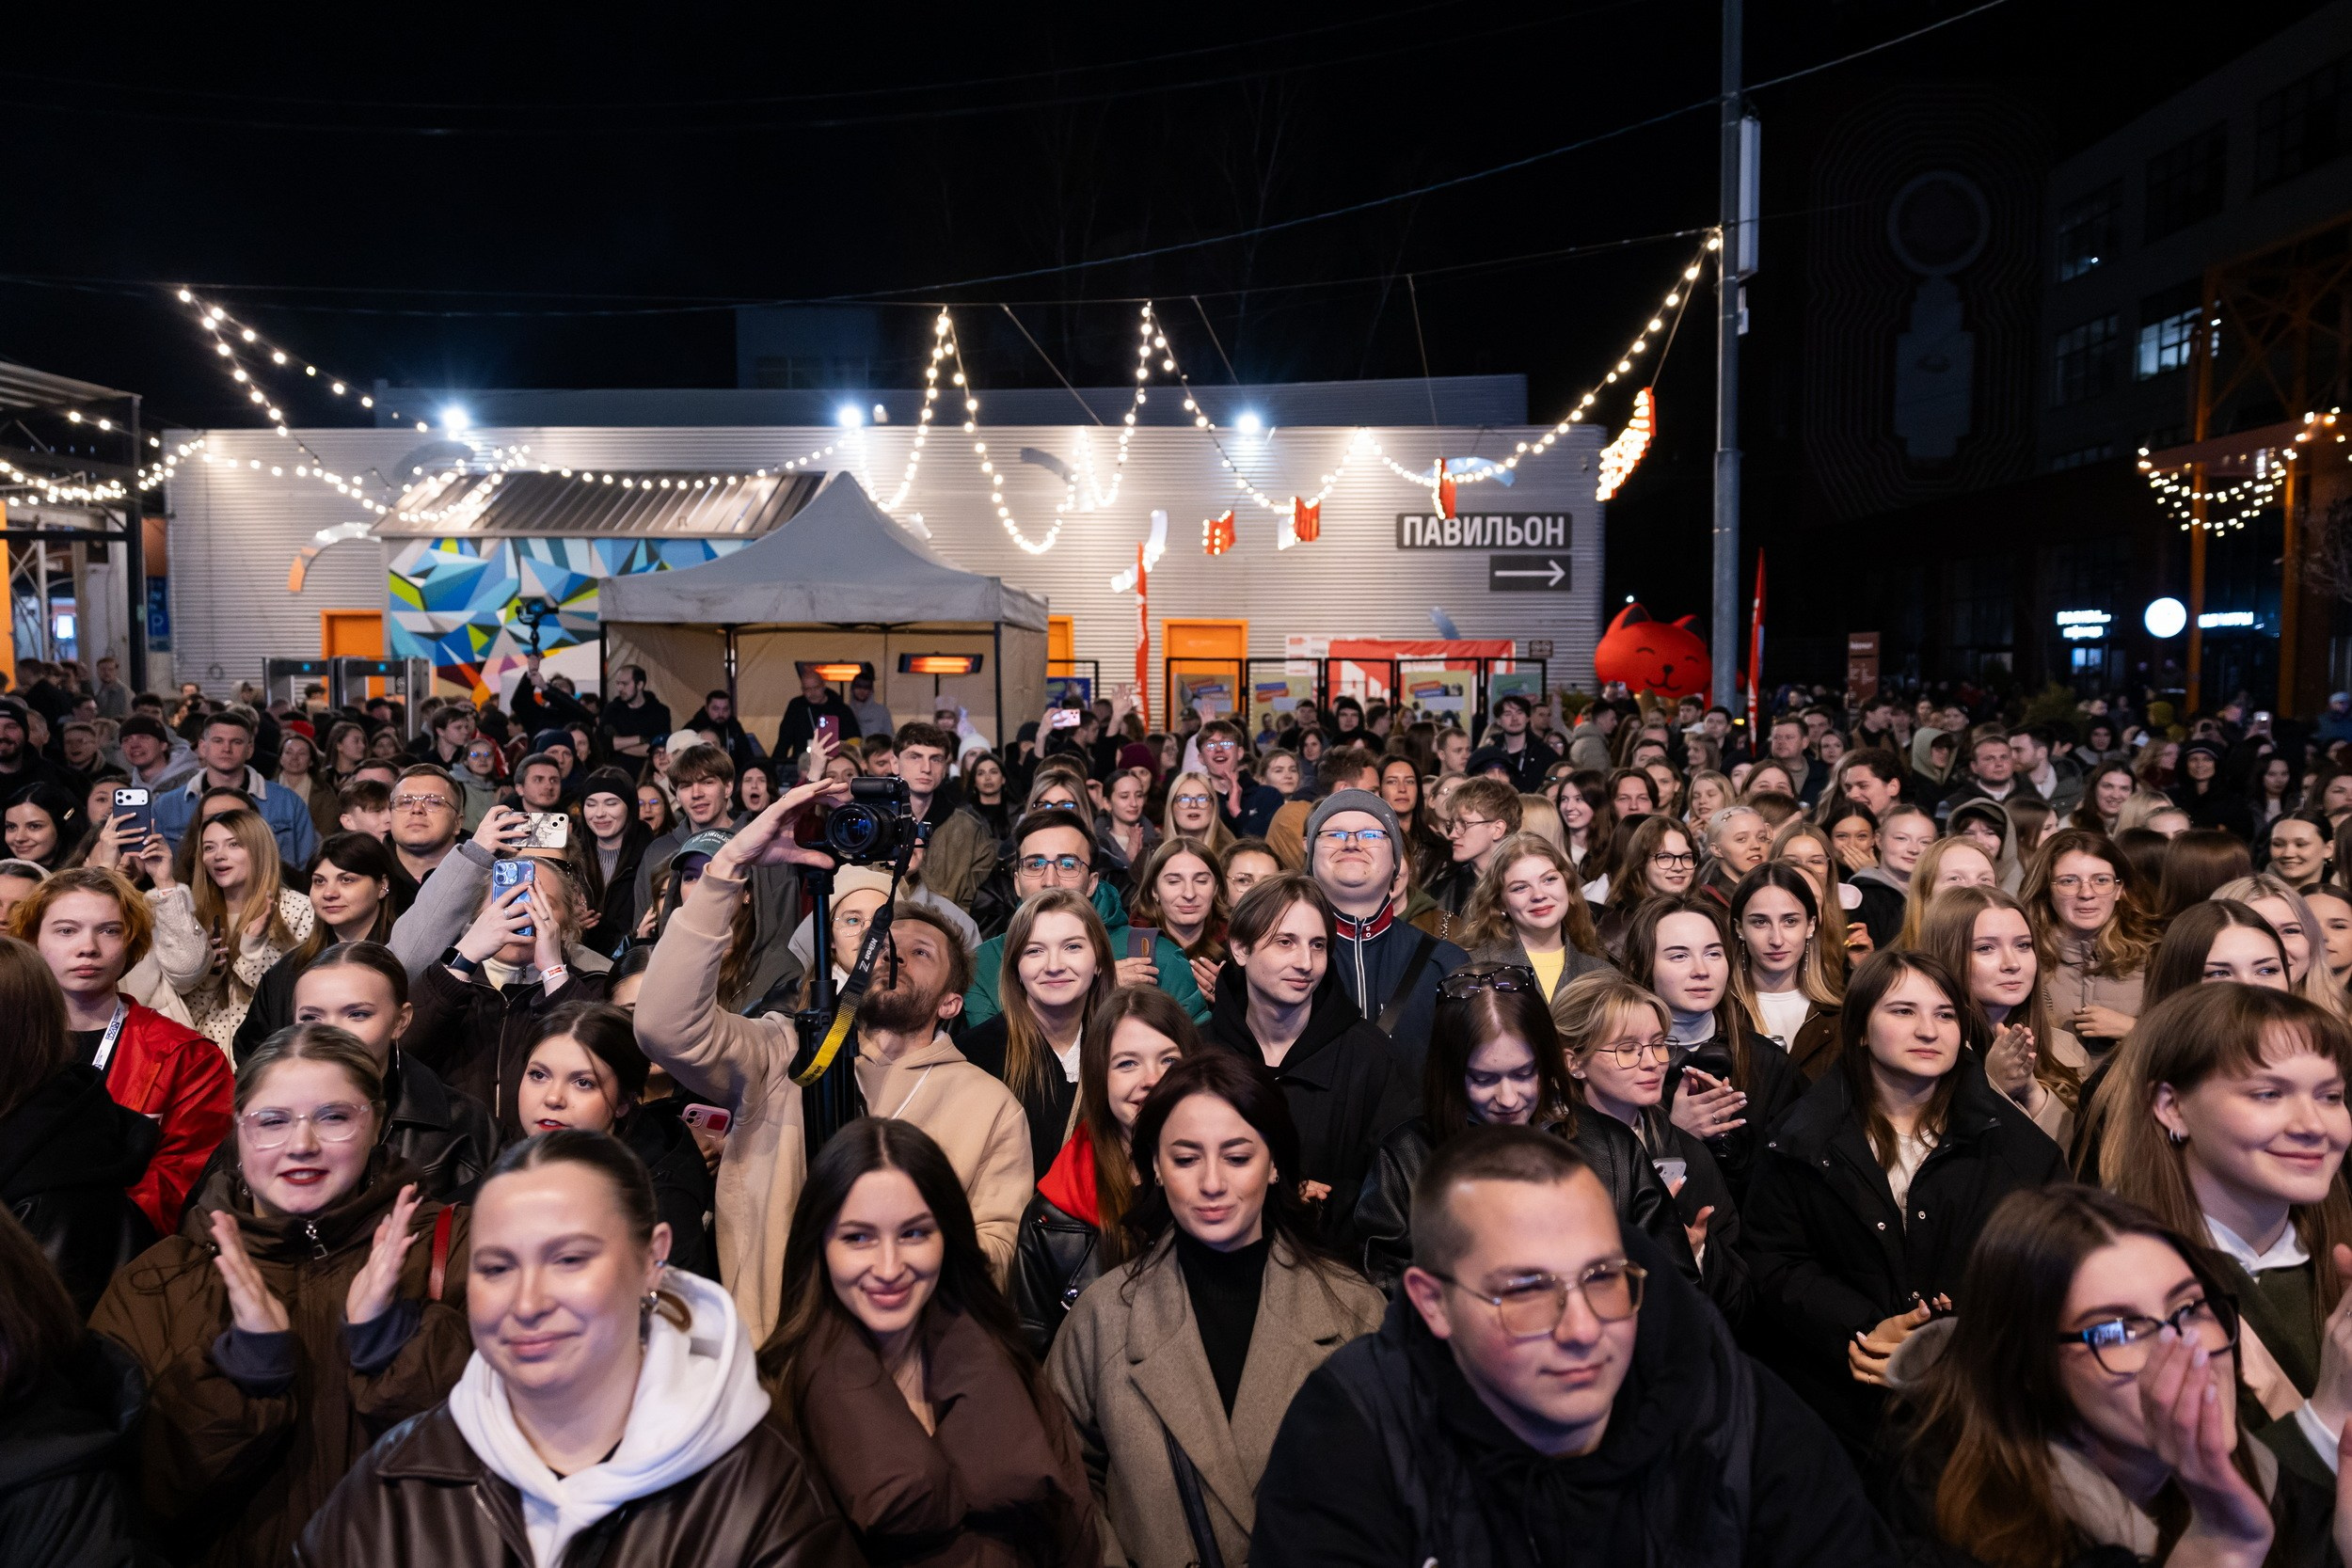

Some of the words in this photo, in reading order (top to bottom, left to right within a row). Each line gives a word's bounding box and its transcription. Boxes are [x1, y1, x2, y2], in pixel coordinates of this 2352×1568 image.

[1403, 516, 1565, 546] ПАВИЛЬОН
[864, 937, 878, 960] Nikon
[805, 1065, 823, 1082] Nikon
